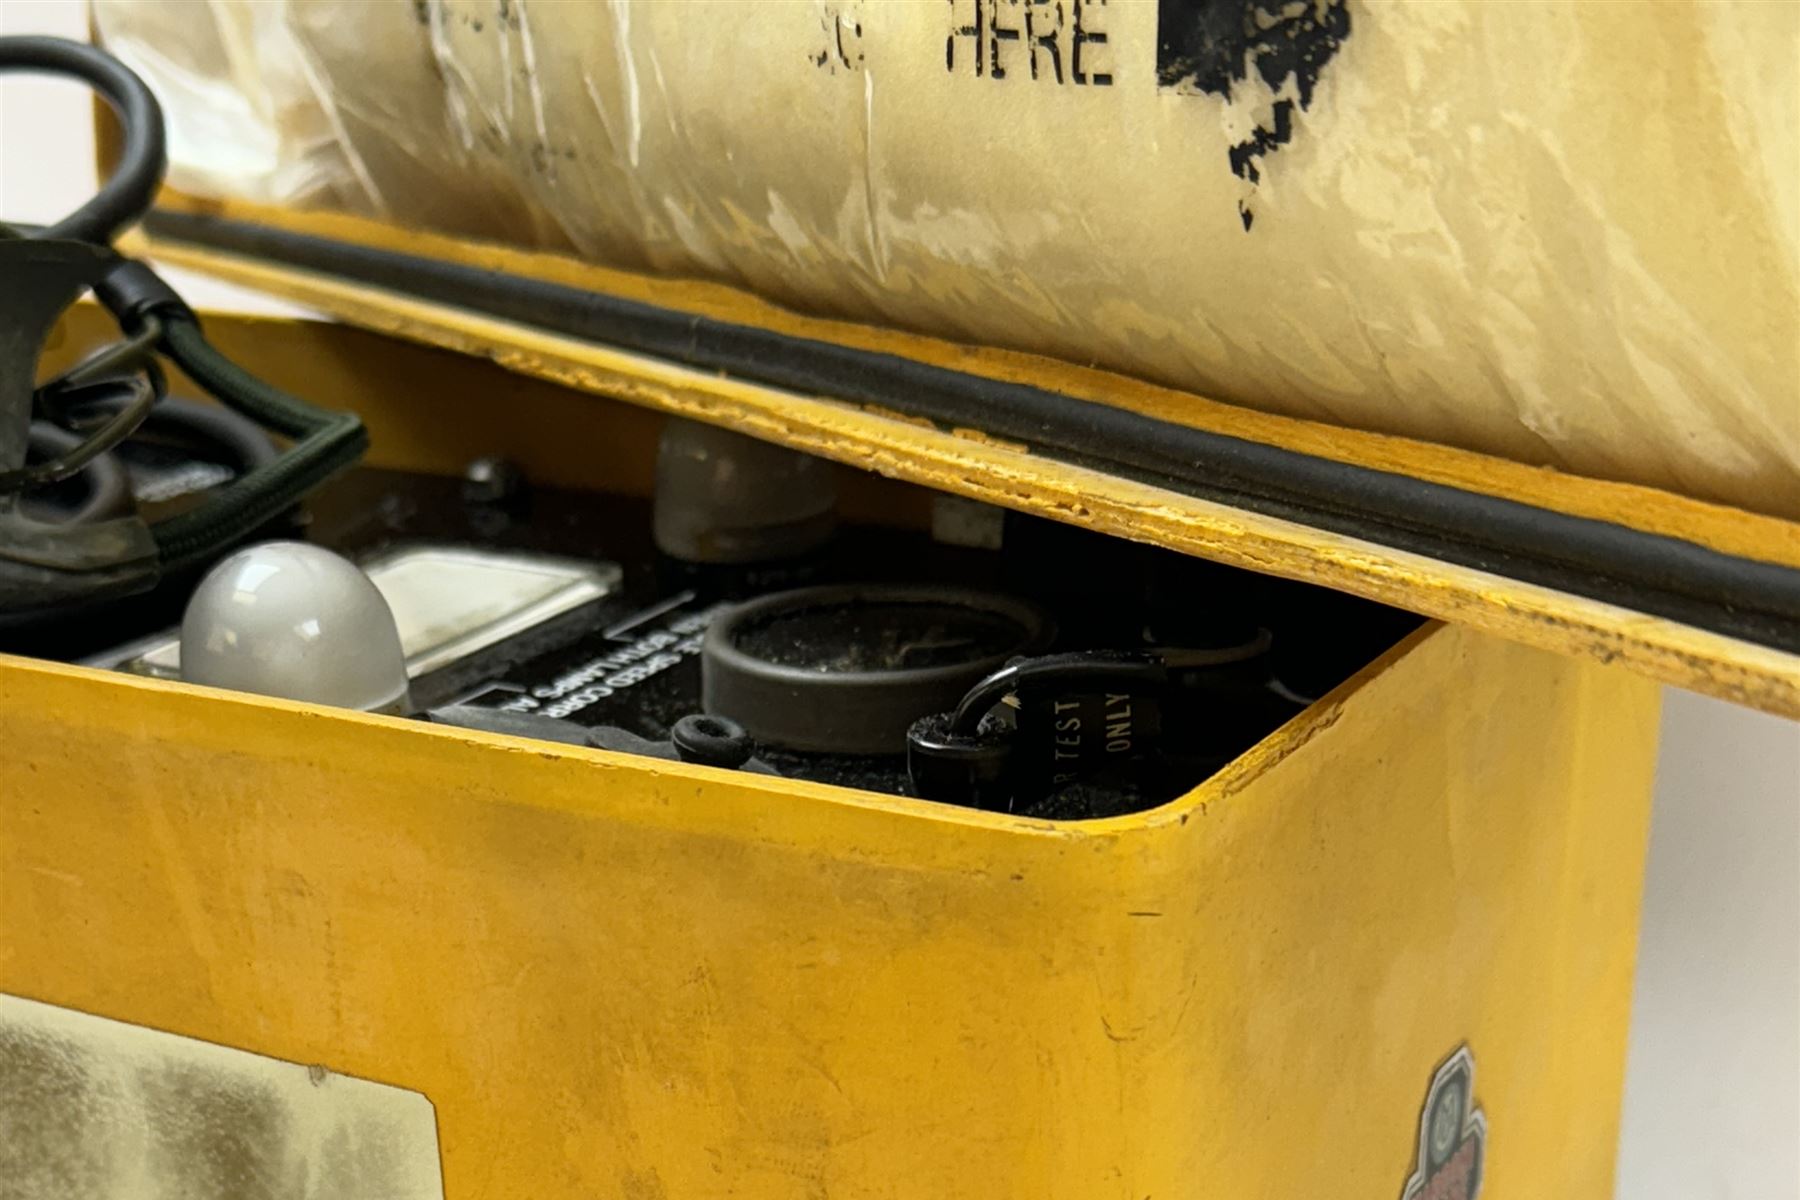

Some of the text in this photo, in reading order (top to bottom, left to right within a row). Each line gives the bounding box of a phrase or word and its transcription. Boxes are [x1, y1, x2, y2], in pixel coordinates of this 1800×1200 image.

[946, 0, 1113, 86] HERE
[1054, 701, 1081, 761] TEST
[1105, 693, 1131, 752] ONLY
